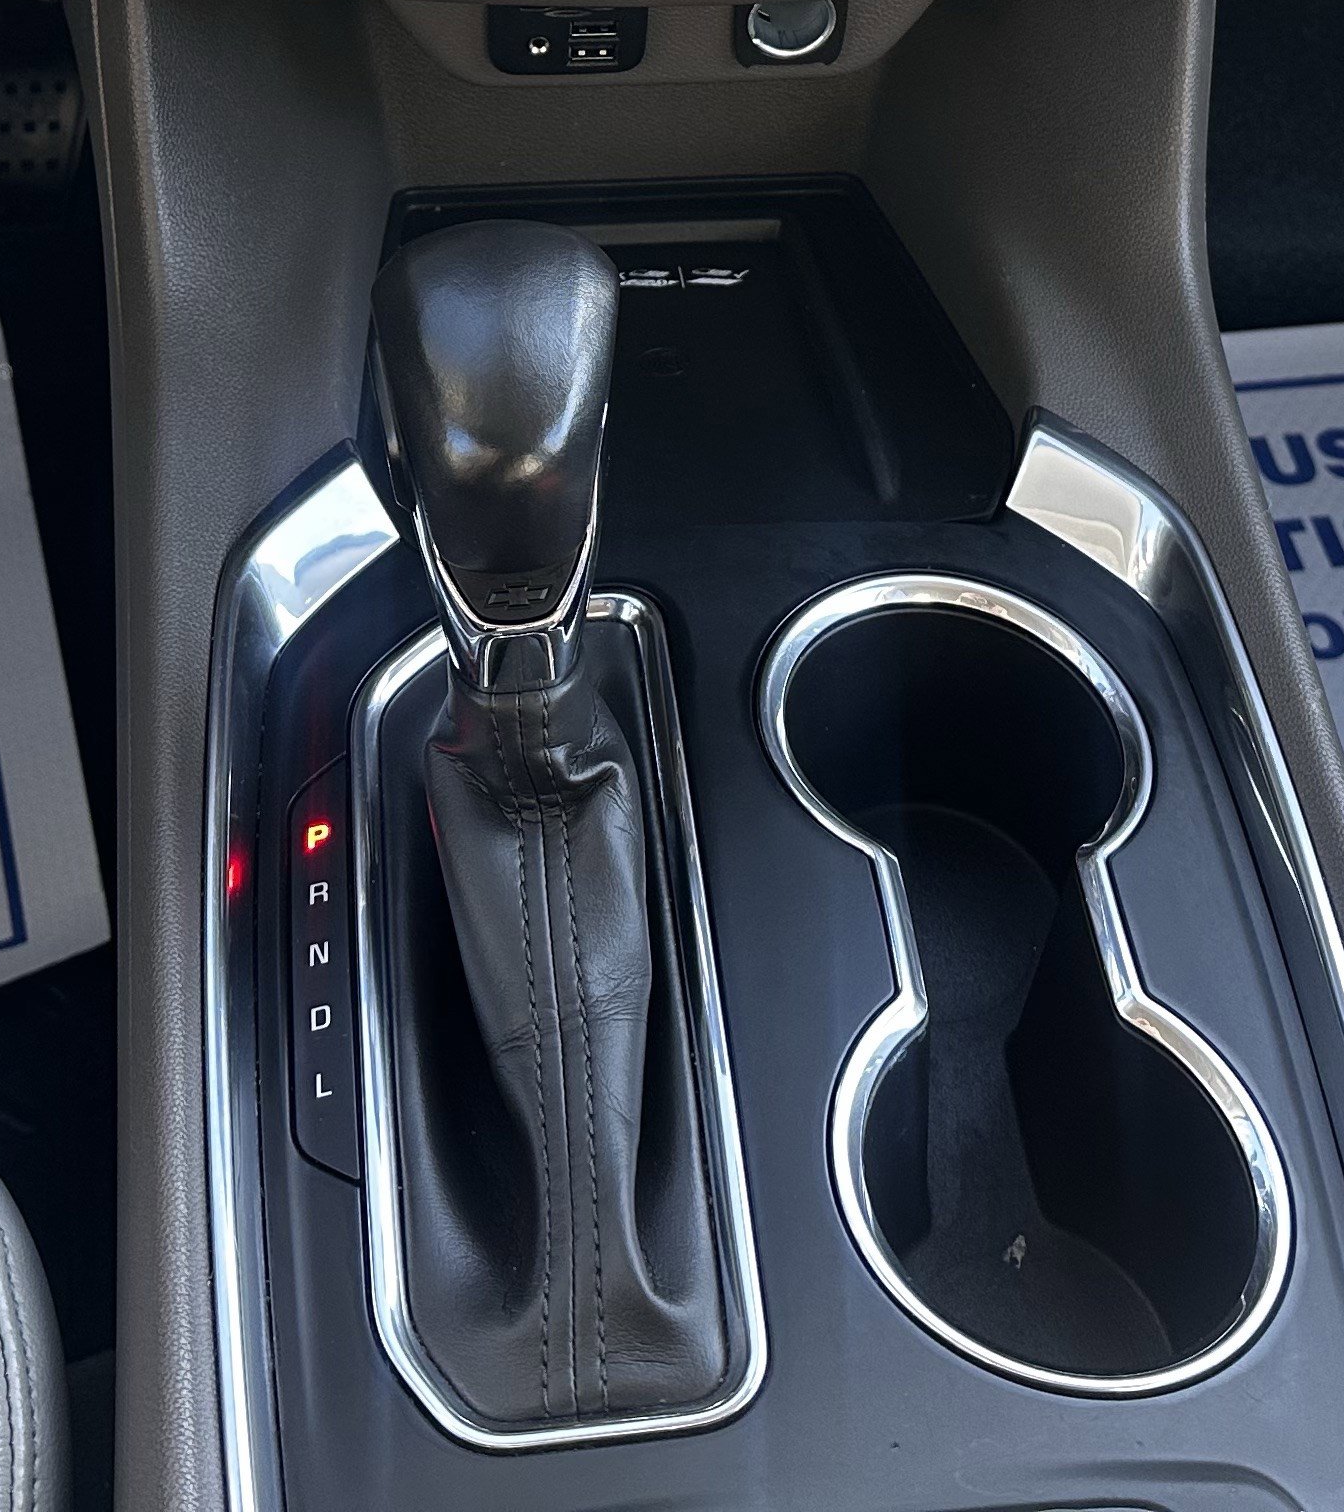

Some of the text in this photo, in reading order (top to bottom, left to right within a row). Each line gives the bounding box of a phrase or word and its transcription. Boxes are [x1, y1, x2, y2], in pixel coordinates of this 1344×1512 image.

[307, 823, 331, 849] P
[308, 881, 330, 905] R
[309, 941, 330, 966] N
[310, 1004, 332, 1032] D
[315, 1073, 333, 1098] L
